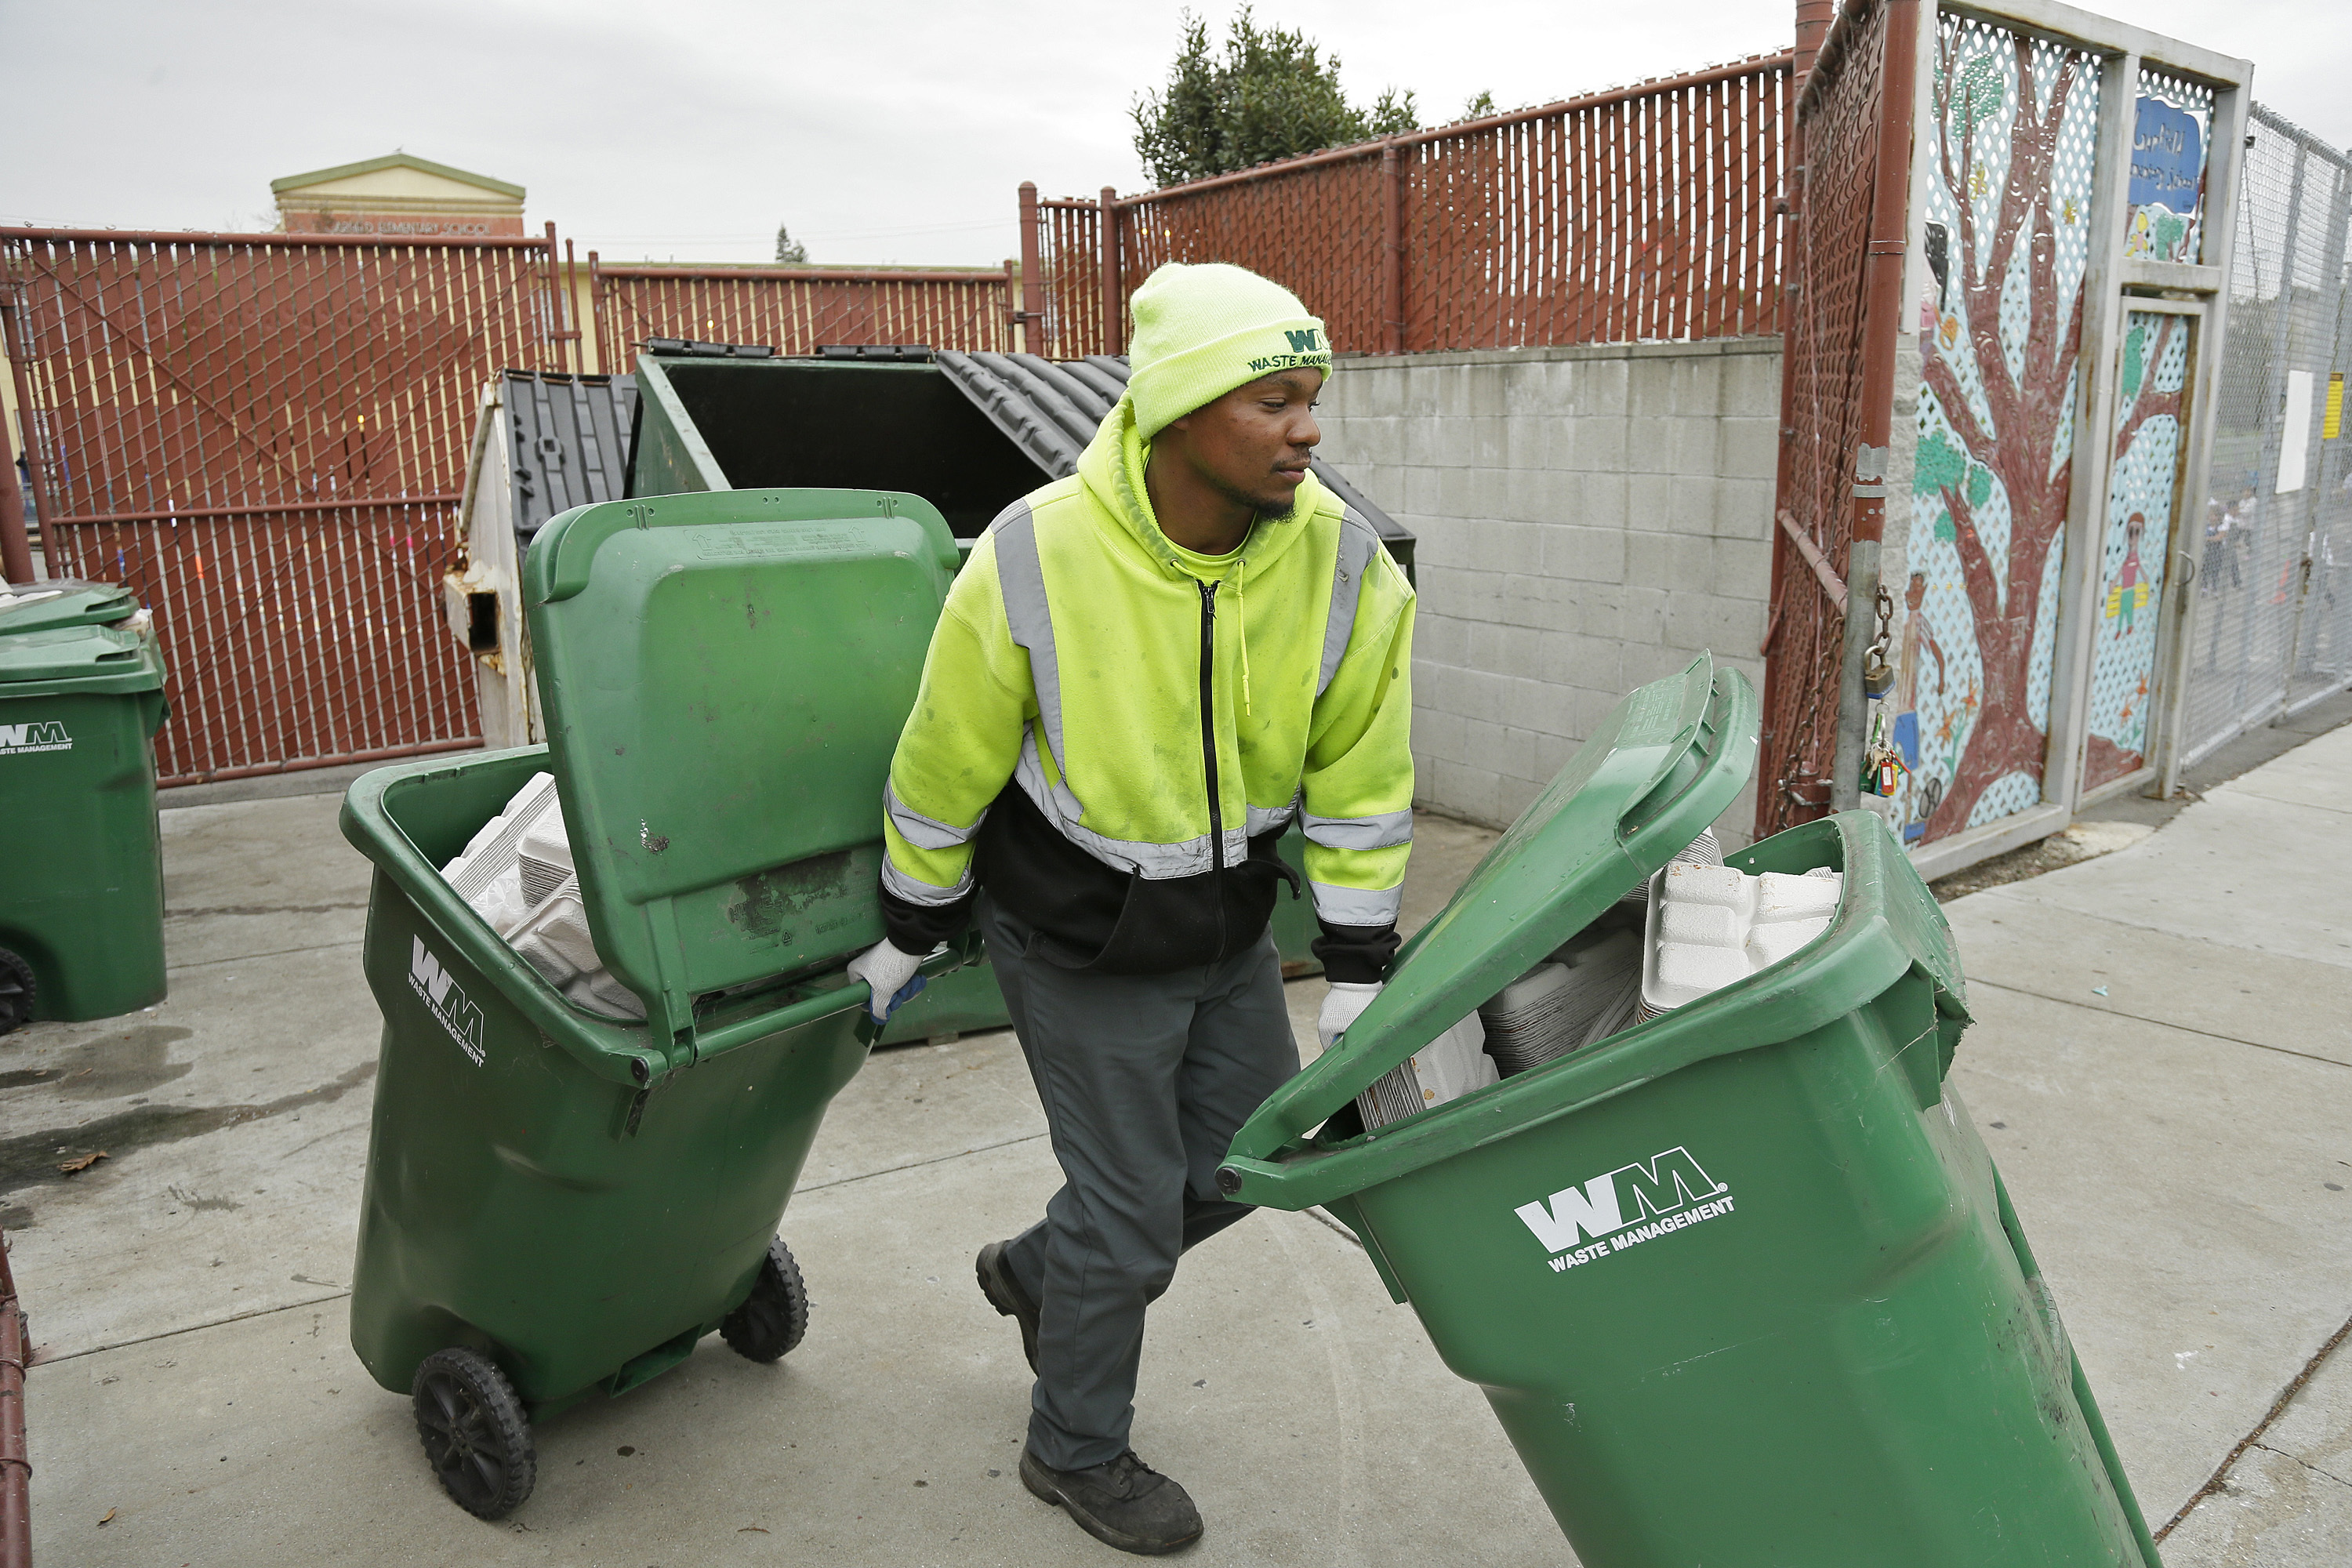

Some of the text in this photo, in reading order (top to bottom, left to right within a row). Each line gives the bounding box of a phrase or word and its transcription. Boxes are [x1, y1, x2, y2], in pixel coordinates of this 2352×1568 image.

[442, 223, 491, 235] SCHOOL
[1247, 354, 1297, 372] WASTE
[17, 742, 73, 753] MANAGEMENT
[408, 972, 485, 1068] WASTE MANAGEMENT
[1547, 1196, 1735, 1273] WASTE MANAGEMENT
